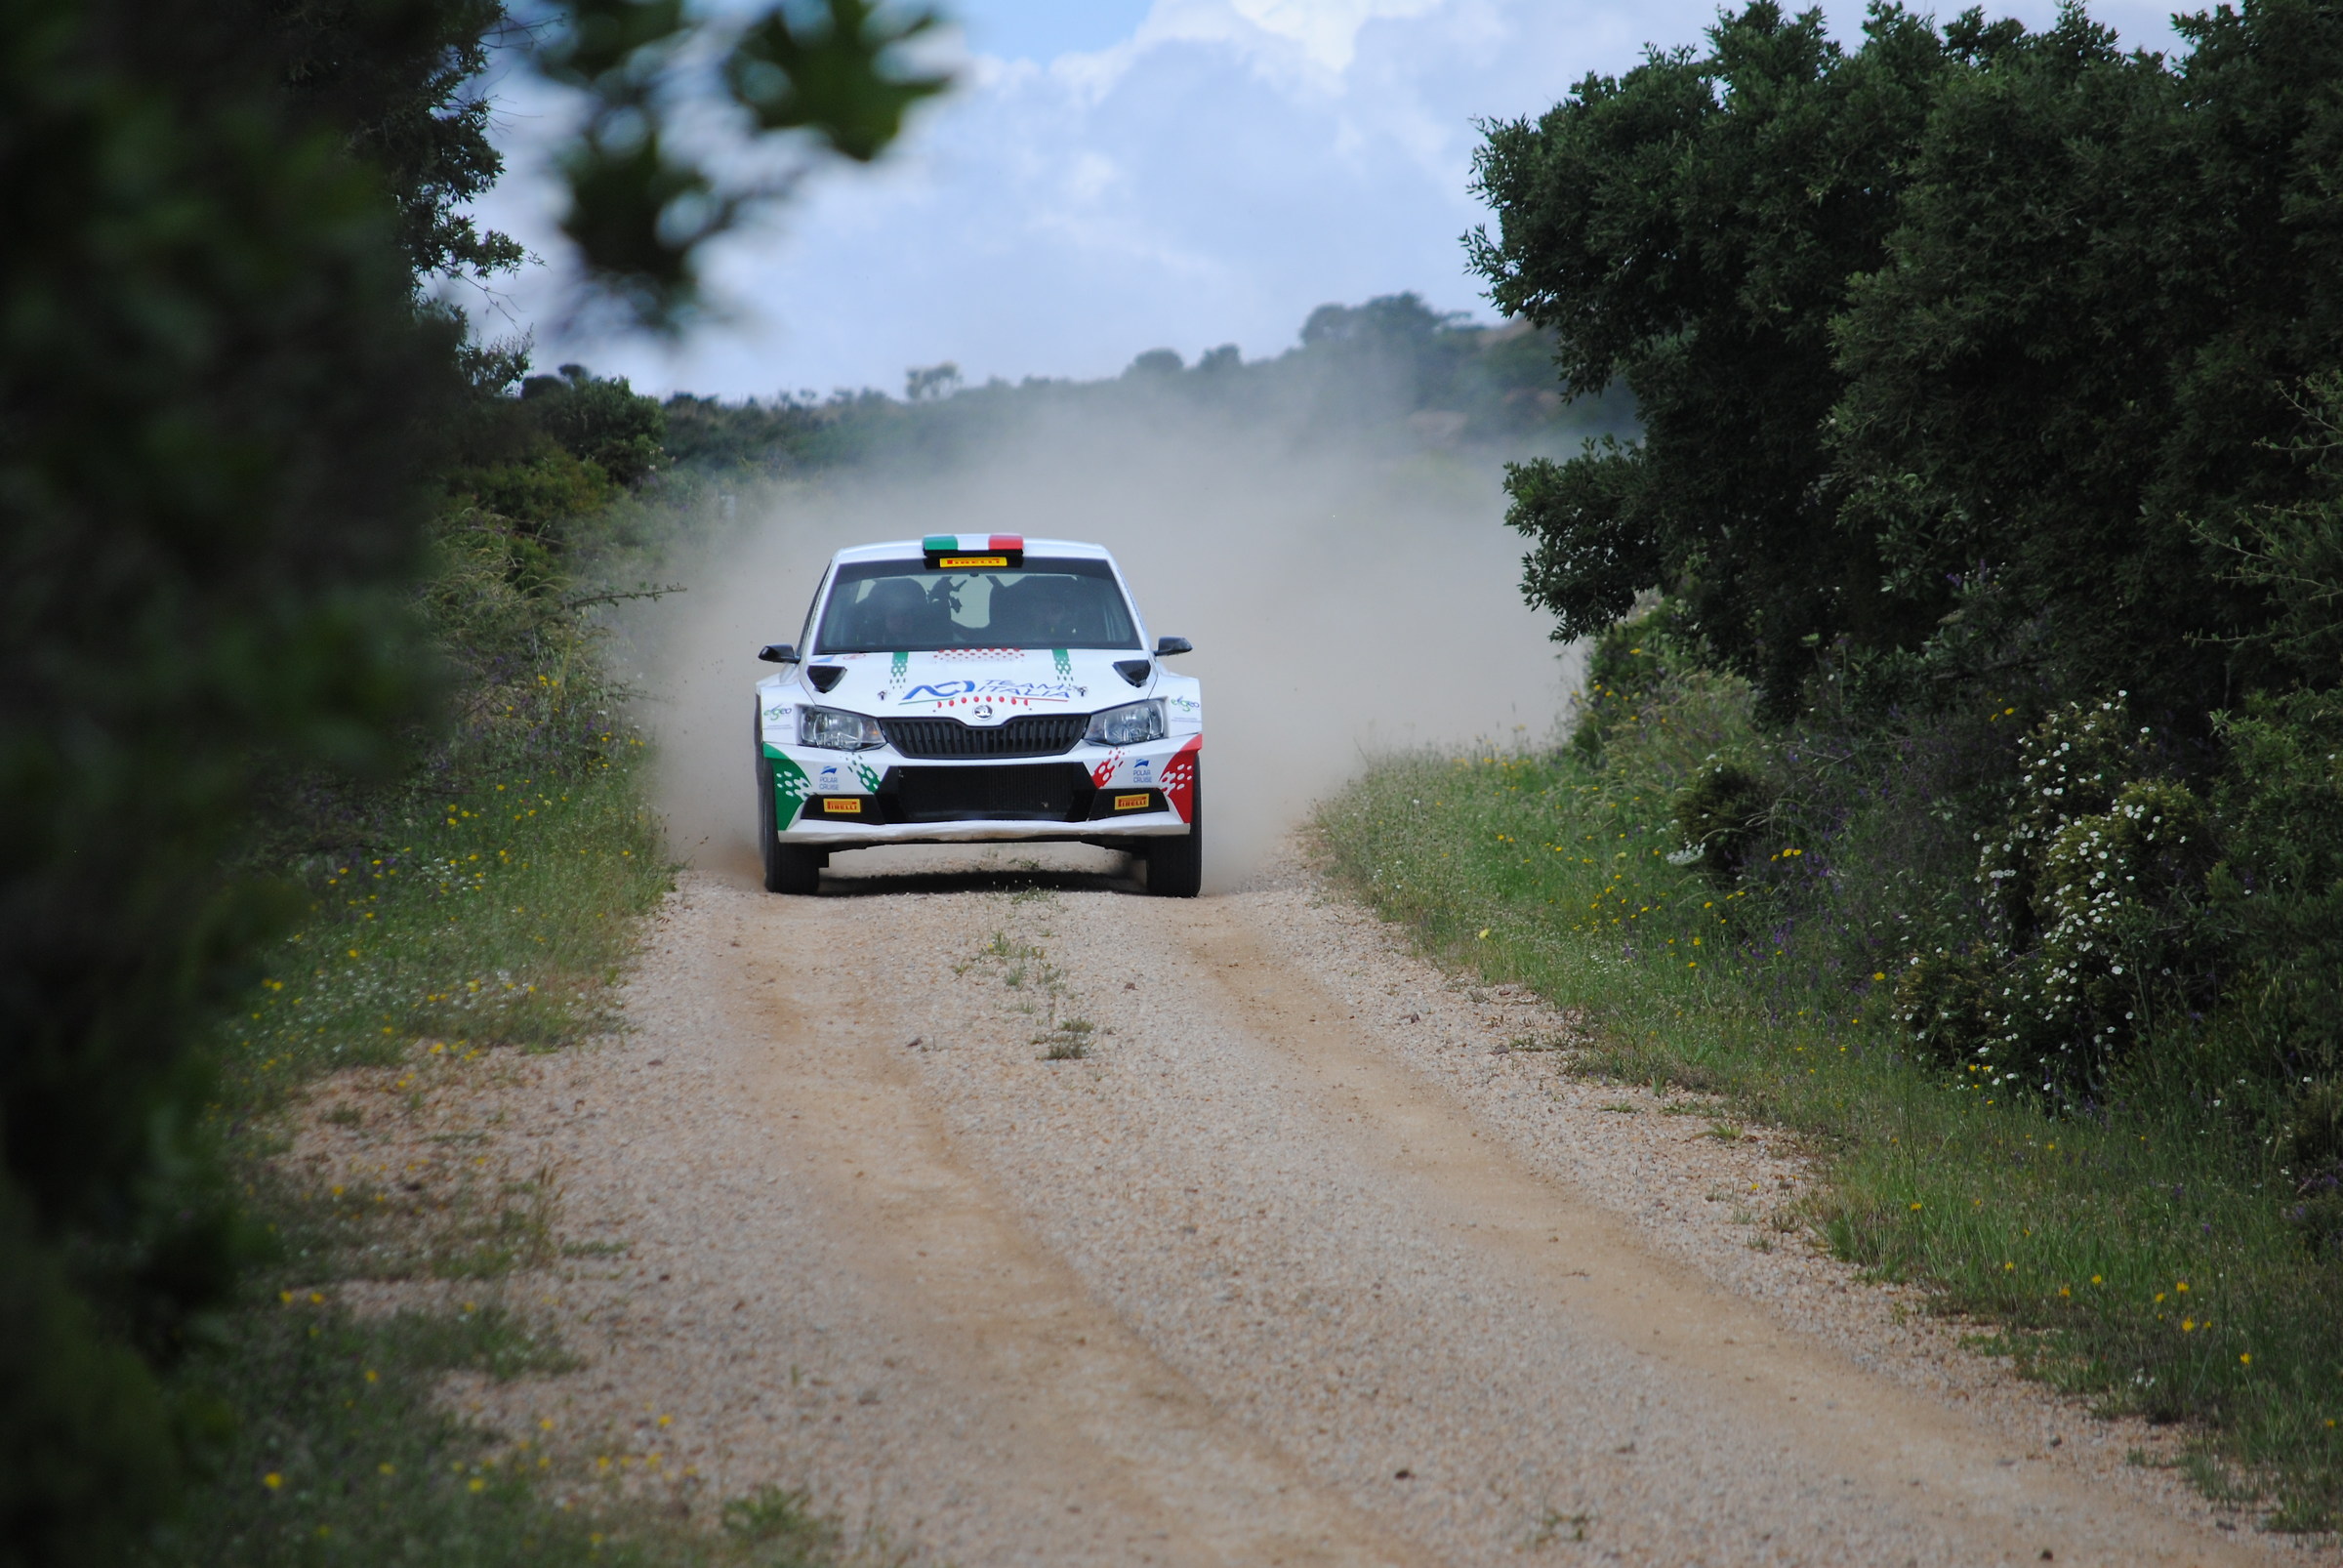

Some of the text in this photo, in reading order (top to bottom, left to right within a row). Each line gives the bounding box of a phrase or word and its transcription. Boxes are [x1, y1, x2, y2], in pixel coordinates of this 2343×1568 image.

[902, 680, 976, 700] ACI
[985, 679, 1064, 690] TEAM
[977, 685, 1070, 698] ITALIA
[827, 801, 857, 810] PIRELLI
[1118, 796, 1147, 807] PIRELLI
